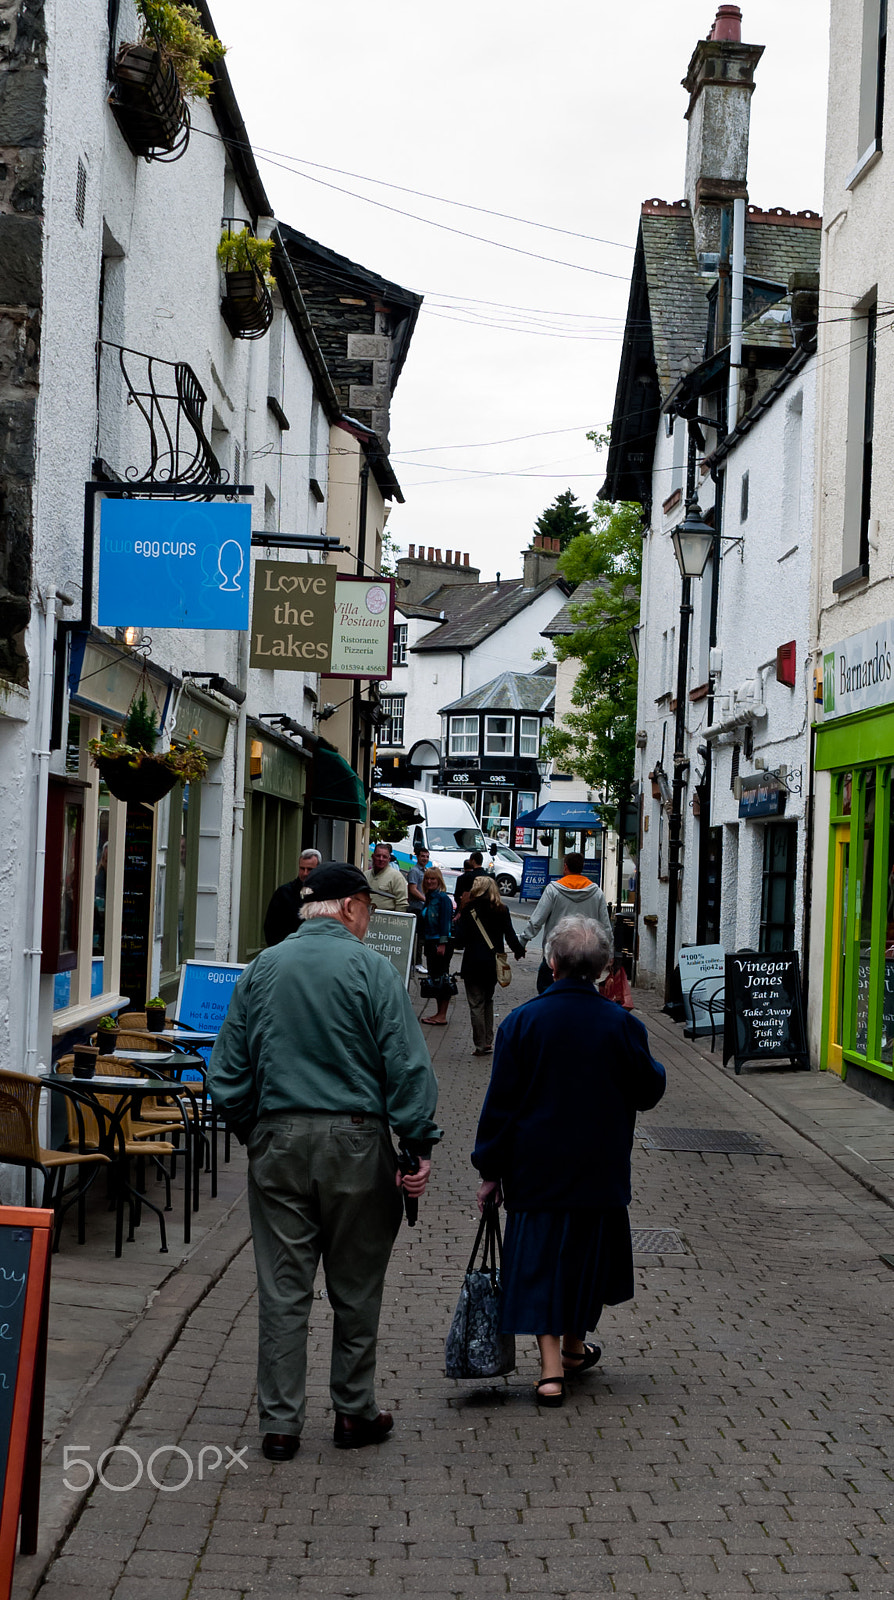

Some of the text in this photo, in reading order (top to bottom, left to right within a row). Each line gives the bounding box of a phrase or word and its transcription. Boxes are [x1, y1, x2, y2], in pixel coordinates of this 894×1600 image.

[334, 602, 358, 615] Villa
[274, 602, 314, 626] the
[340, 615, 386, 628] Positano
[340, 636, 379, 645] Ristorante
[255, 634, 329, 659] Lakes
[344, 646, 374, 655] Pizzeria
[840, 640, 892, 696] Barnardo's
[525, 876, 545, 885] £16.95
[378, 932, 402, 942] home
[734, 960, 792, 975] Vinegar
[744, 975, 783, 988] Jones
[752, 991, 767, 999] Eat
[201, 1002, 210, 1010] All
[211, 1003, 225, 1011] Day
[190, 1011, 202, 1019] Hot
[742, 1008, 792, 1017] Take Away
[752, 1019, 784, 1027] Quality
[754, 1029, 773, 1038] Fish
[758, 1039, 781, 1049] Chips
